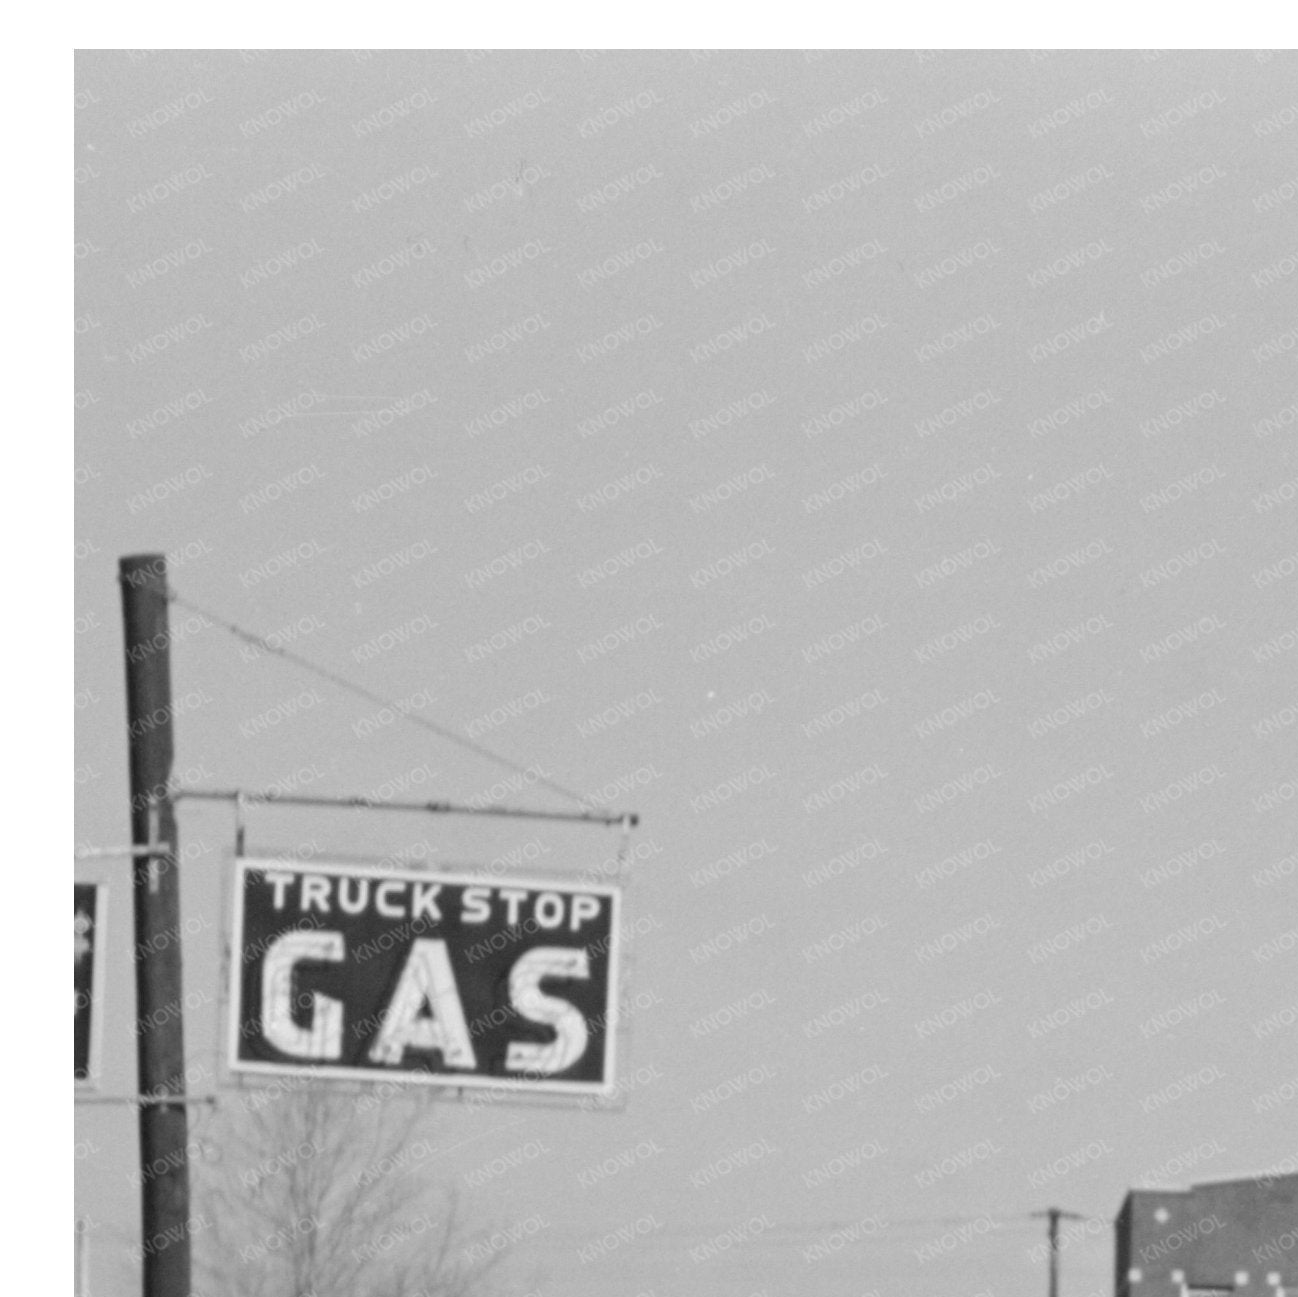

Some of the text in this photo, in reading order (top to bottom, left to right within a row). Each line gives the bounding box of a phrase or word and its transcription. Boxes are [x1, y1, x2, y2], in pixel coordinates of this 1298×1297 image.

[264, 872, 600, 931] TRUCK STOP
[262, 929, 590, 1074] GAS
